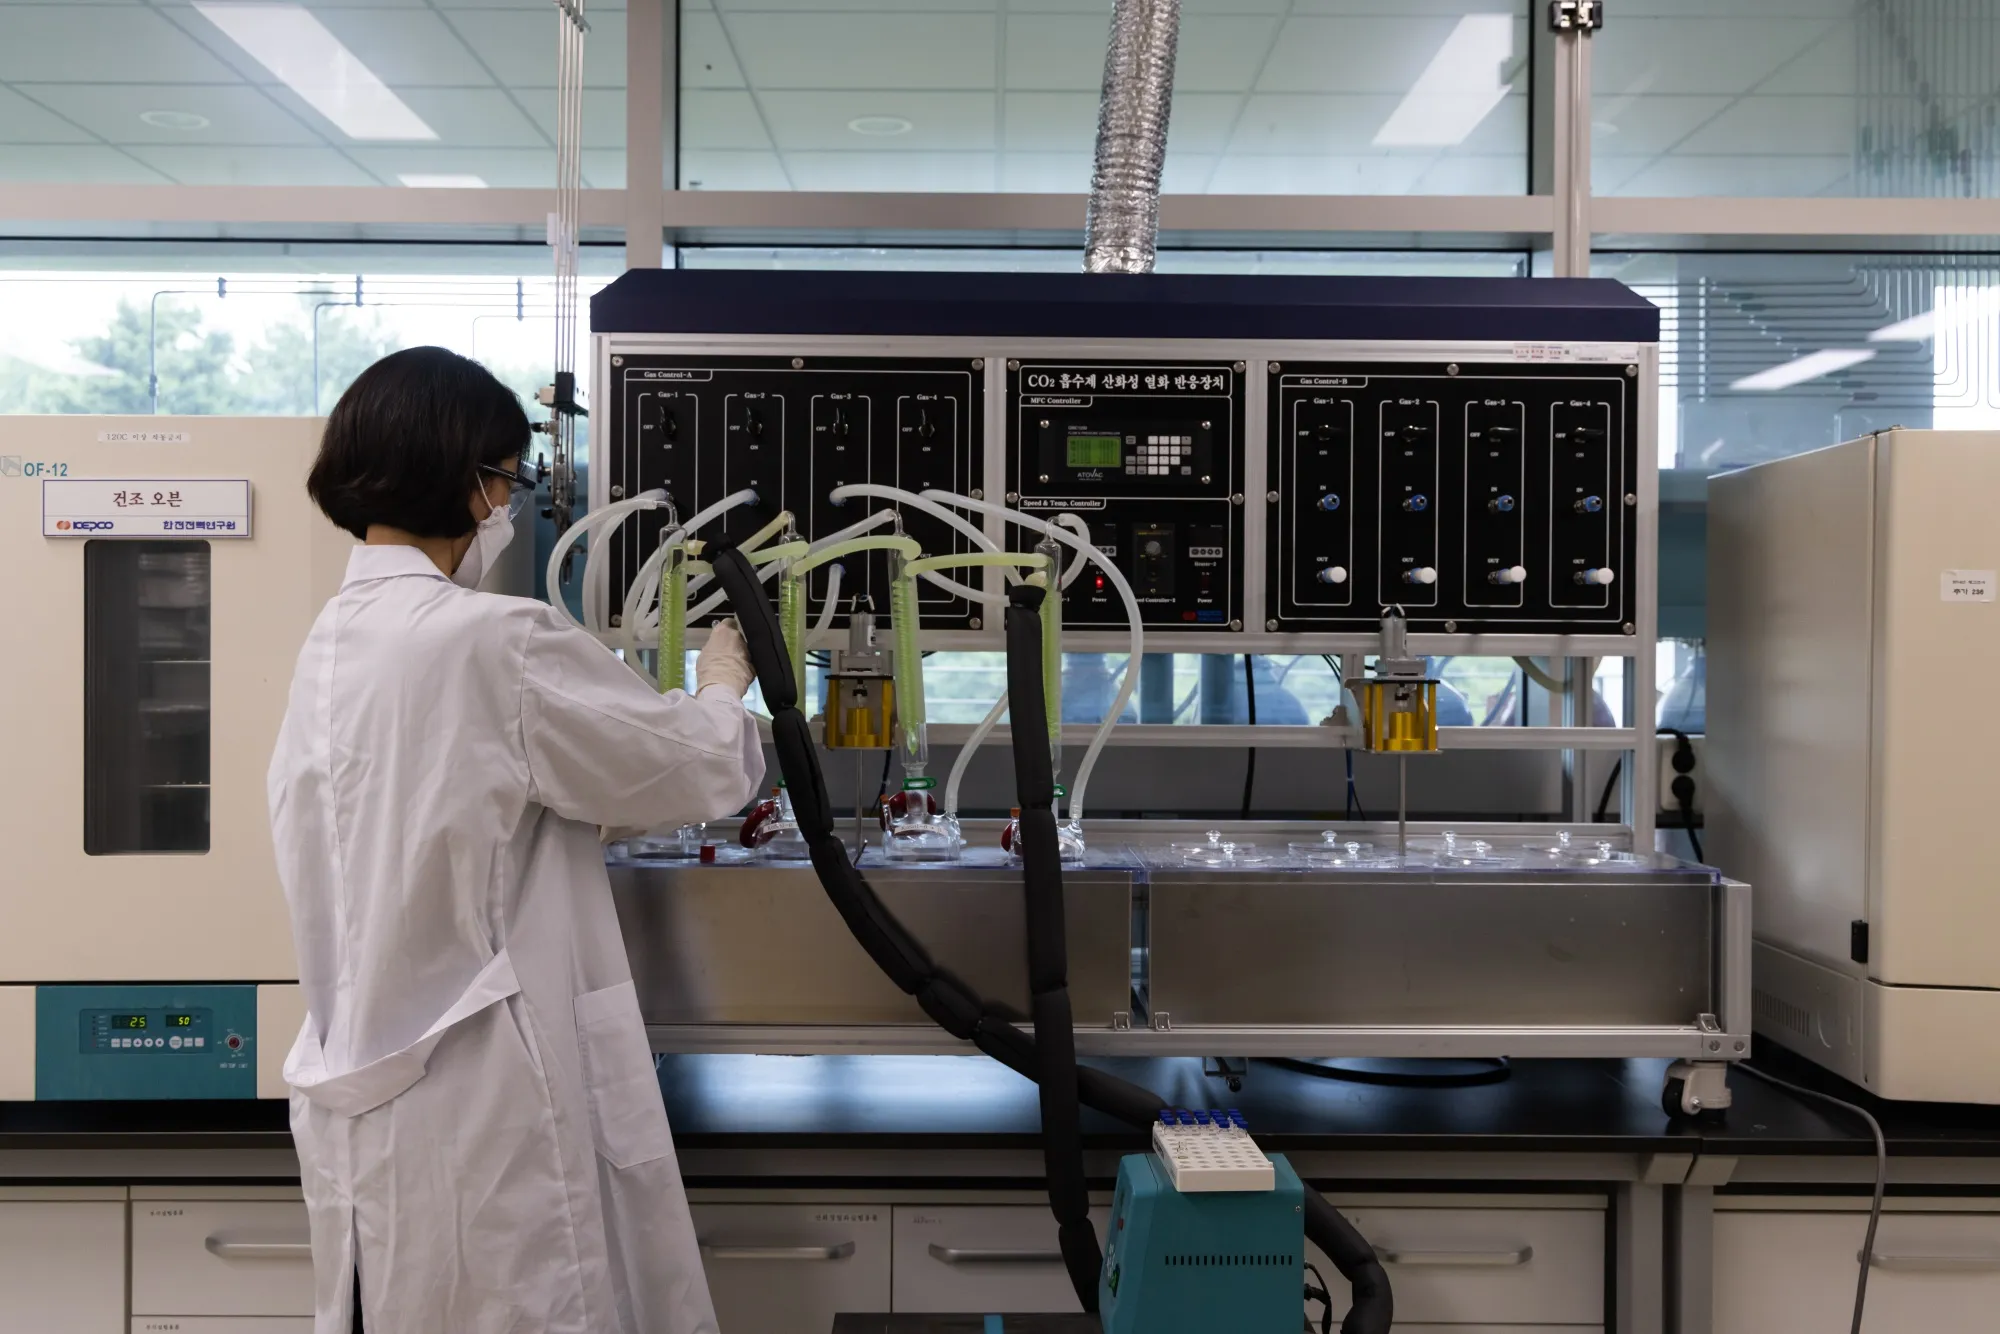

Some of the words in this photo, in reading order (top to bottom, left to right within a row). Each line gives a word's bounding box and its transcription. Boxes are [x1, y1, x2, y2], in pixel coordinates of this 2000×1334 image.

[657, 371, 693, 379] Control-A
[1058, 373, 1097, 389] 흡수제
[1101, 373, 1139, 390] 산화성
[1144, 374, 1170, 390] 열화
[1174, 374, 1224, 391] 반응장치
[1300, 377, 1313, 385] Gas
[1313, 377, 1348, 385] Control-B
[743, 391, 766, 399] Gas-2
[830, 392, 852, 400] Gas-3
[916, 393, 938, 401] Gas-4
[1046, 397, 1082, 405] Controller
[1313, 397, 1334, 405] Gas-1
[1398, 398, 1420, 406] Gas-2
[1484, 398, 1506, 406] Gas-3
[1569, 399, 1591, 407] Gas-4
[24, 462, 68, 477] OF-12
[113, 491, 145, 507] 건조
[150, 491, 183, 507] 오븐
[1023, 499, 1042, 507] Speed
[1042, 499, 1049, 507] &
[1050, 499, 1070, 507] Temp.
[72, 520, 114, 532] KEPCO
[163, 520, 236, 530] 한전전력연구원
[129, 1016, 147, 1028] 25
[178, 1016, 191, 1026] 50
